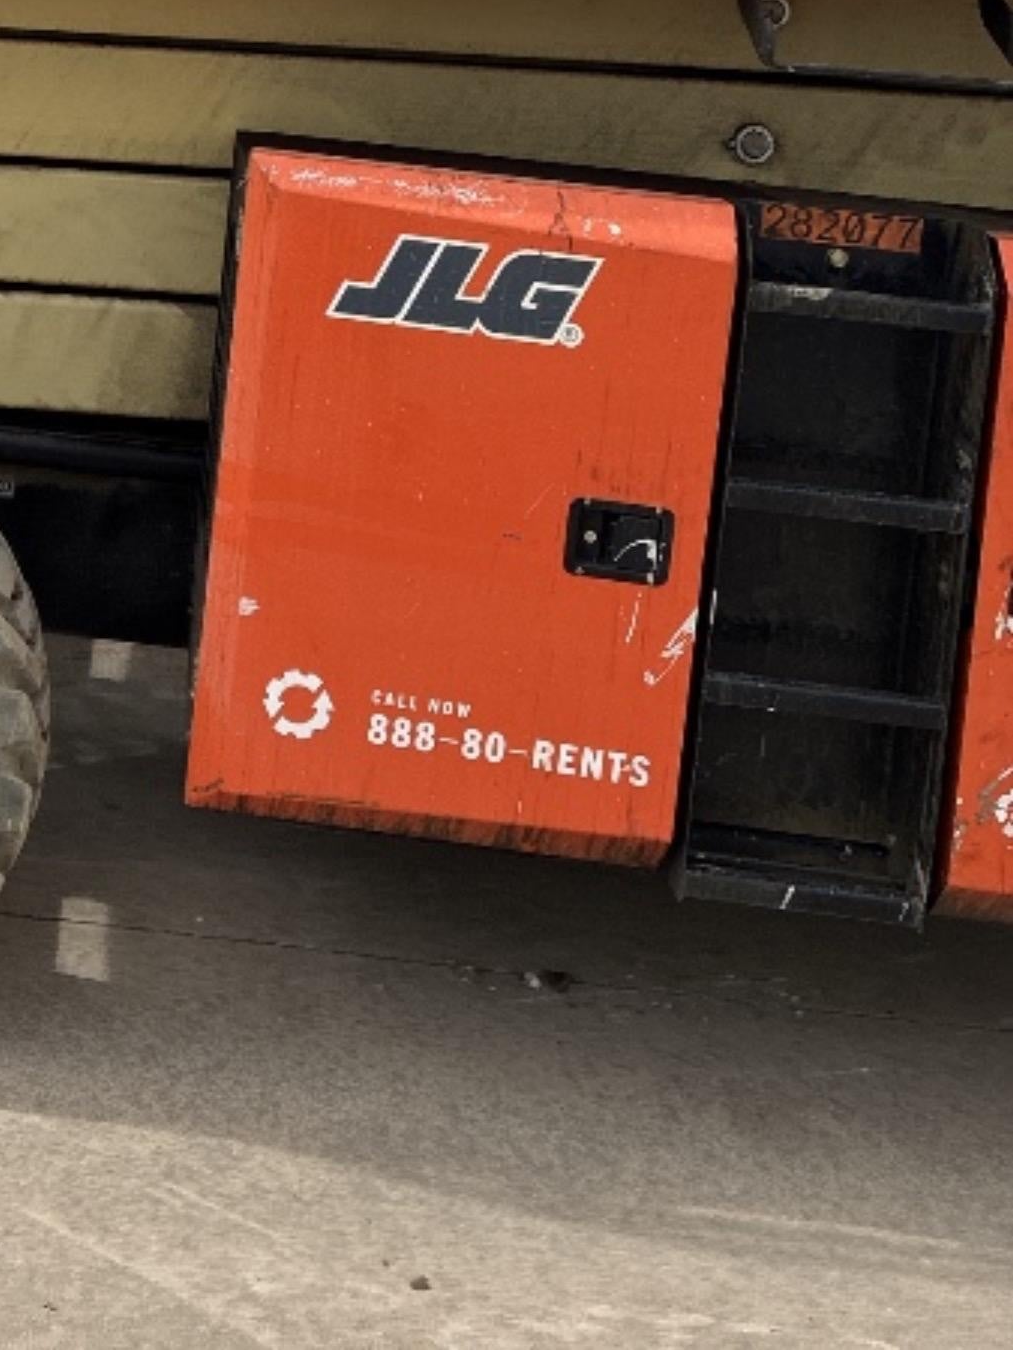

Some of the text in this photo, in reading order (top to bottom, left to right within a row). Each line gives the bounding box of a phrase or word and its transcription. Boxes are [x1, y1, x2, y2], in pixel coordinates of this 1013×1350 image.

[765, 203, 919, 250] 282077
[326, 233, 604, 345] JLG
[370, 688, 472, 719] CALL NOW
[366, 712, 652, 788] 888-80-RENTS
